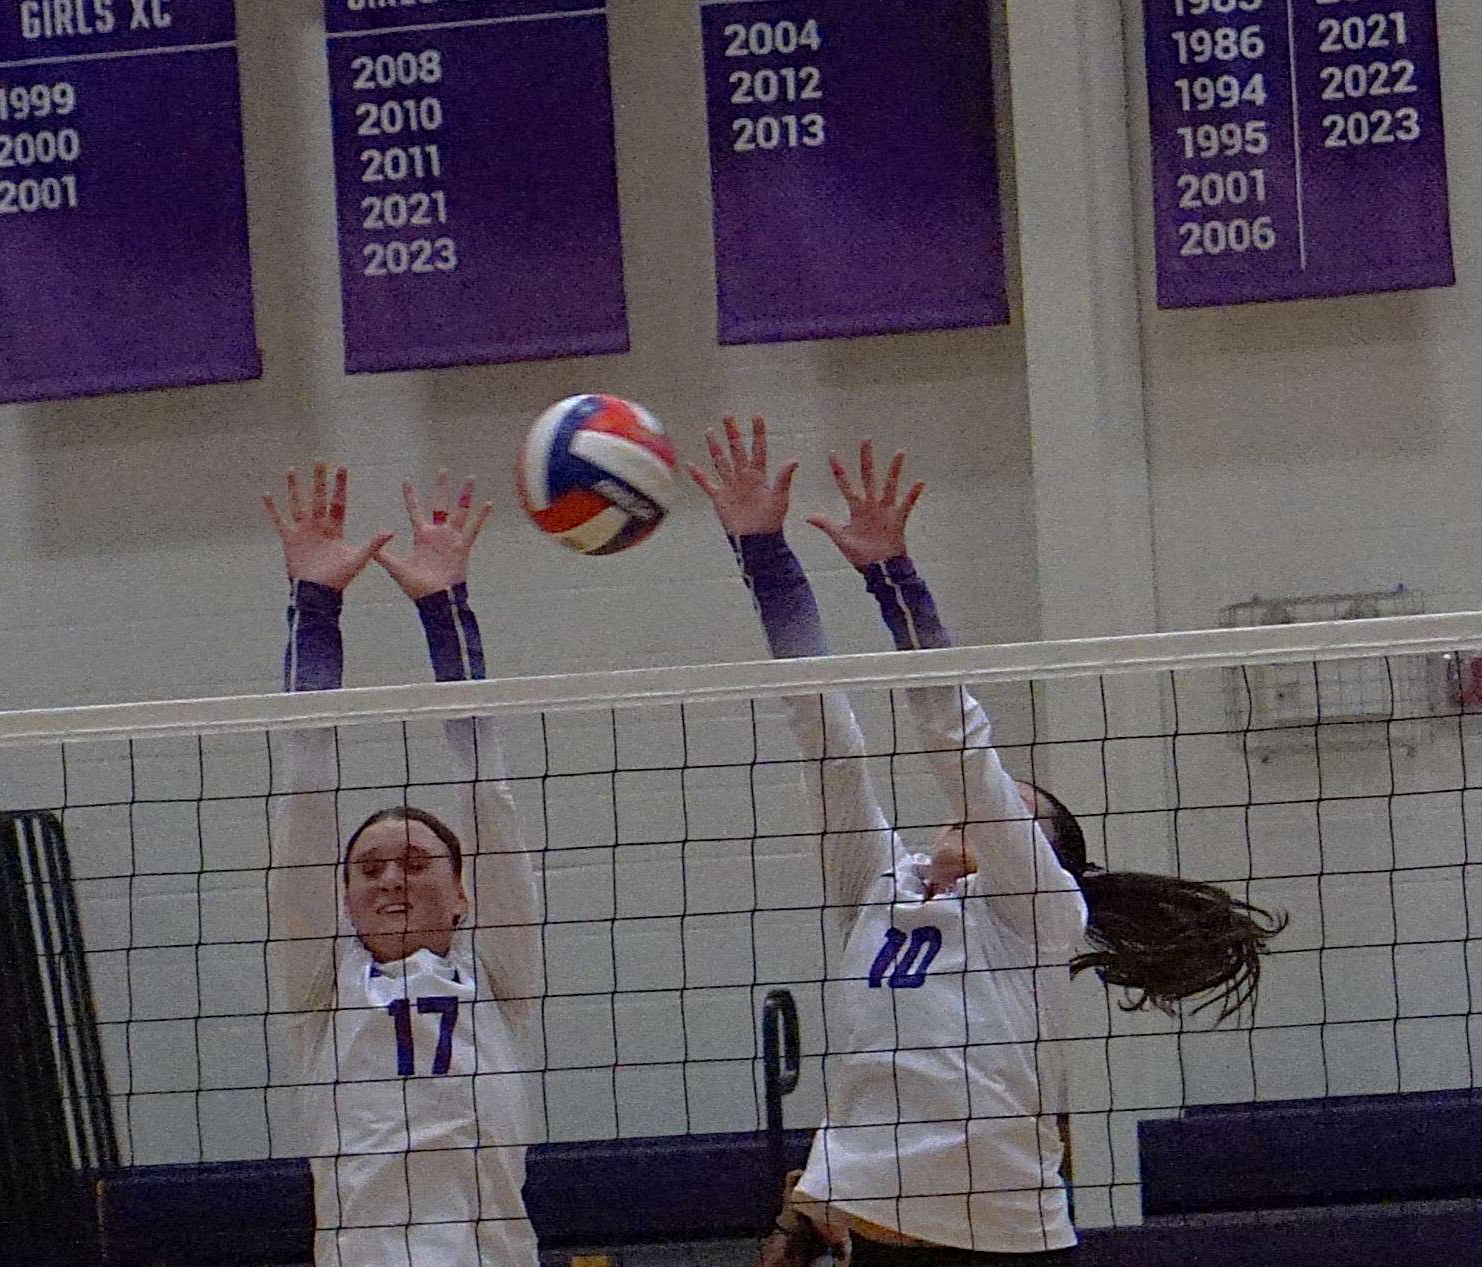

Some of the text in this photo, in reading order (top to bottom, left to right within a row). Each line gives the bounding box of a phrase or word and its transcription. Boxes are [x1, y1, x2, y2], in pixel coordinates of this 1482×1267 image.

[20, 0, 172, 39] GIRLS XC
[723, 18, 821, 57] 2004
[1318, 11, 1407, 53] 2021
[1171, 24, 1265, 64] 1986
[351, 49, 443, 90] 2008
[729, 66, 823, 104] 2012
[1319, 58, 1418, 100] 2022
[1174, 72, 1268, 111] 1994
[355, 96, 443, 136] 2010
[732, 113, 825, 152] 2013
[1322, 107, 1421, 148] 2023
[1176, 120, 1269, 160] 1995
[360, 144, 441, 183] 2011
[1177, 168, 1266, 209] 2001
[361, 190, 447, 230] 2021
[1179, 215, 1276, 257] 2006
[362, 237, 458, 277] 2023
[869, 926, 942, 988] 10
[388, 996, 459, 1076] 17
